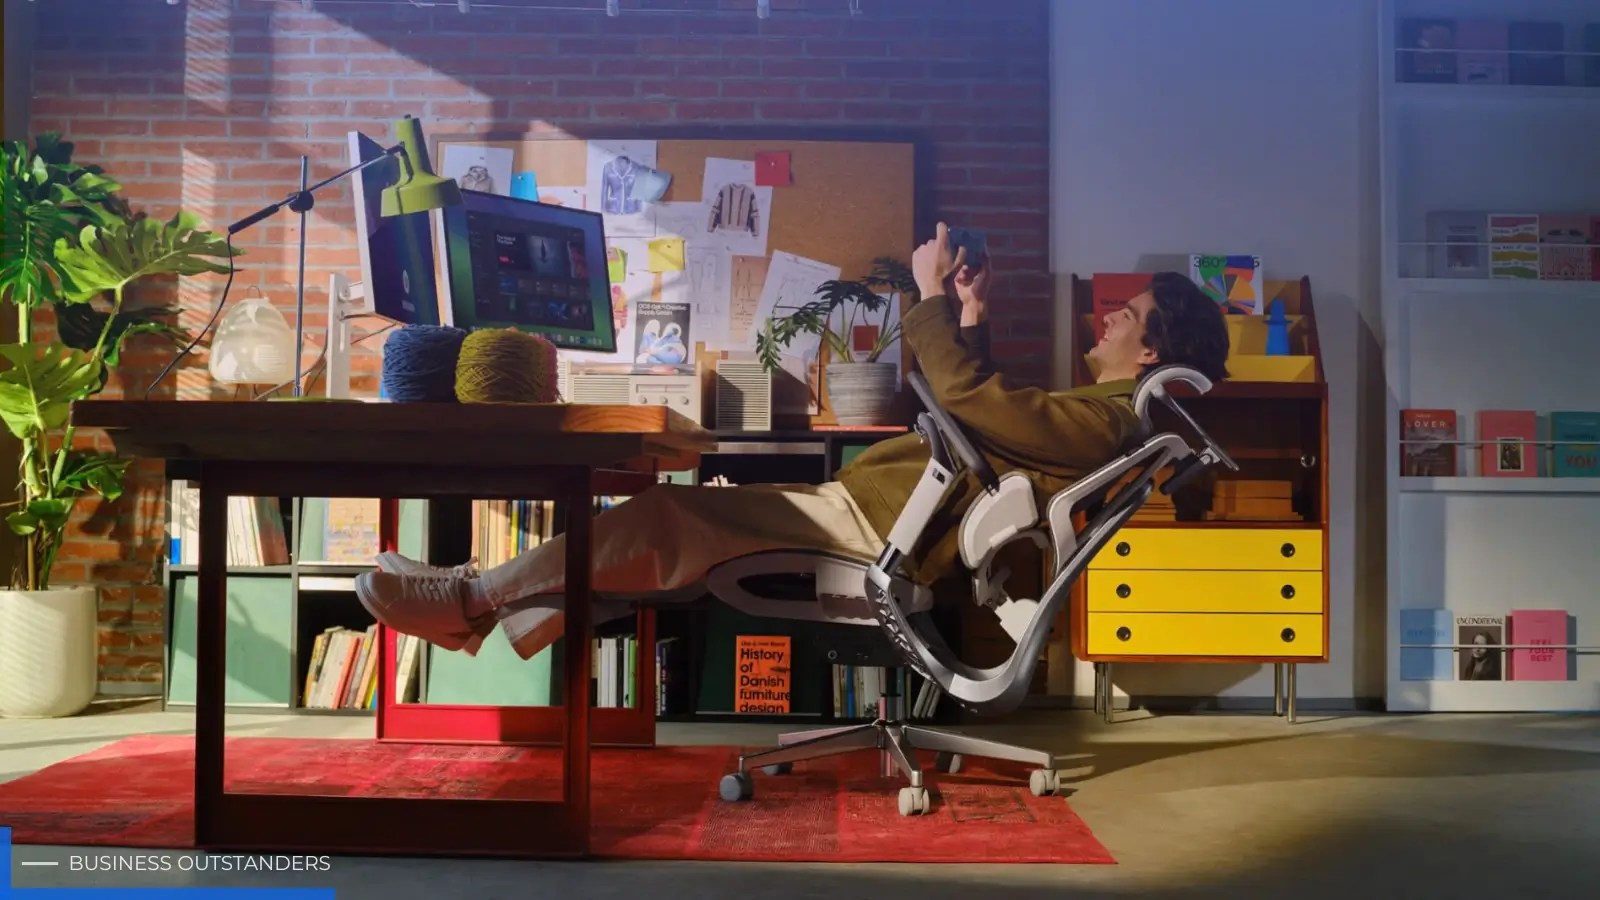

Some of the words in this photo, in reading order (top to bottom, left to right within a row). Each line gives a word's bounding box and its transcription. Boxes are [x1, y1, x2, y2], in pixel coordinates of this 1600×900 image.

[1406, 420, 1447, 428] LOVER
[1565, 455, 1597, 468] YOU
[1456, 617, 1503, 625] UNCONDITIONAL
[740, 648, 784, 662] History
[1530, 654, 1553, 662] BEST
[740, 662, 754, 673] of
[740, 675, 785, 687] Danish
[740, 688, 790, 701] furniture
[740, 702, 784, 713] design
